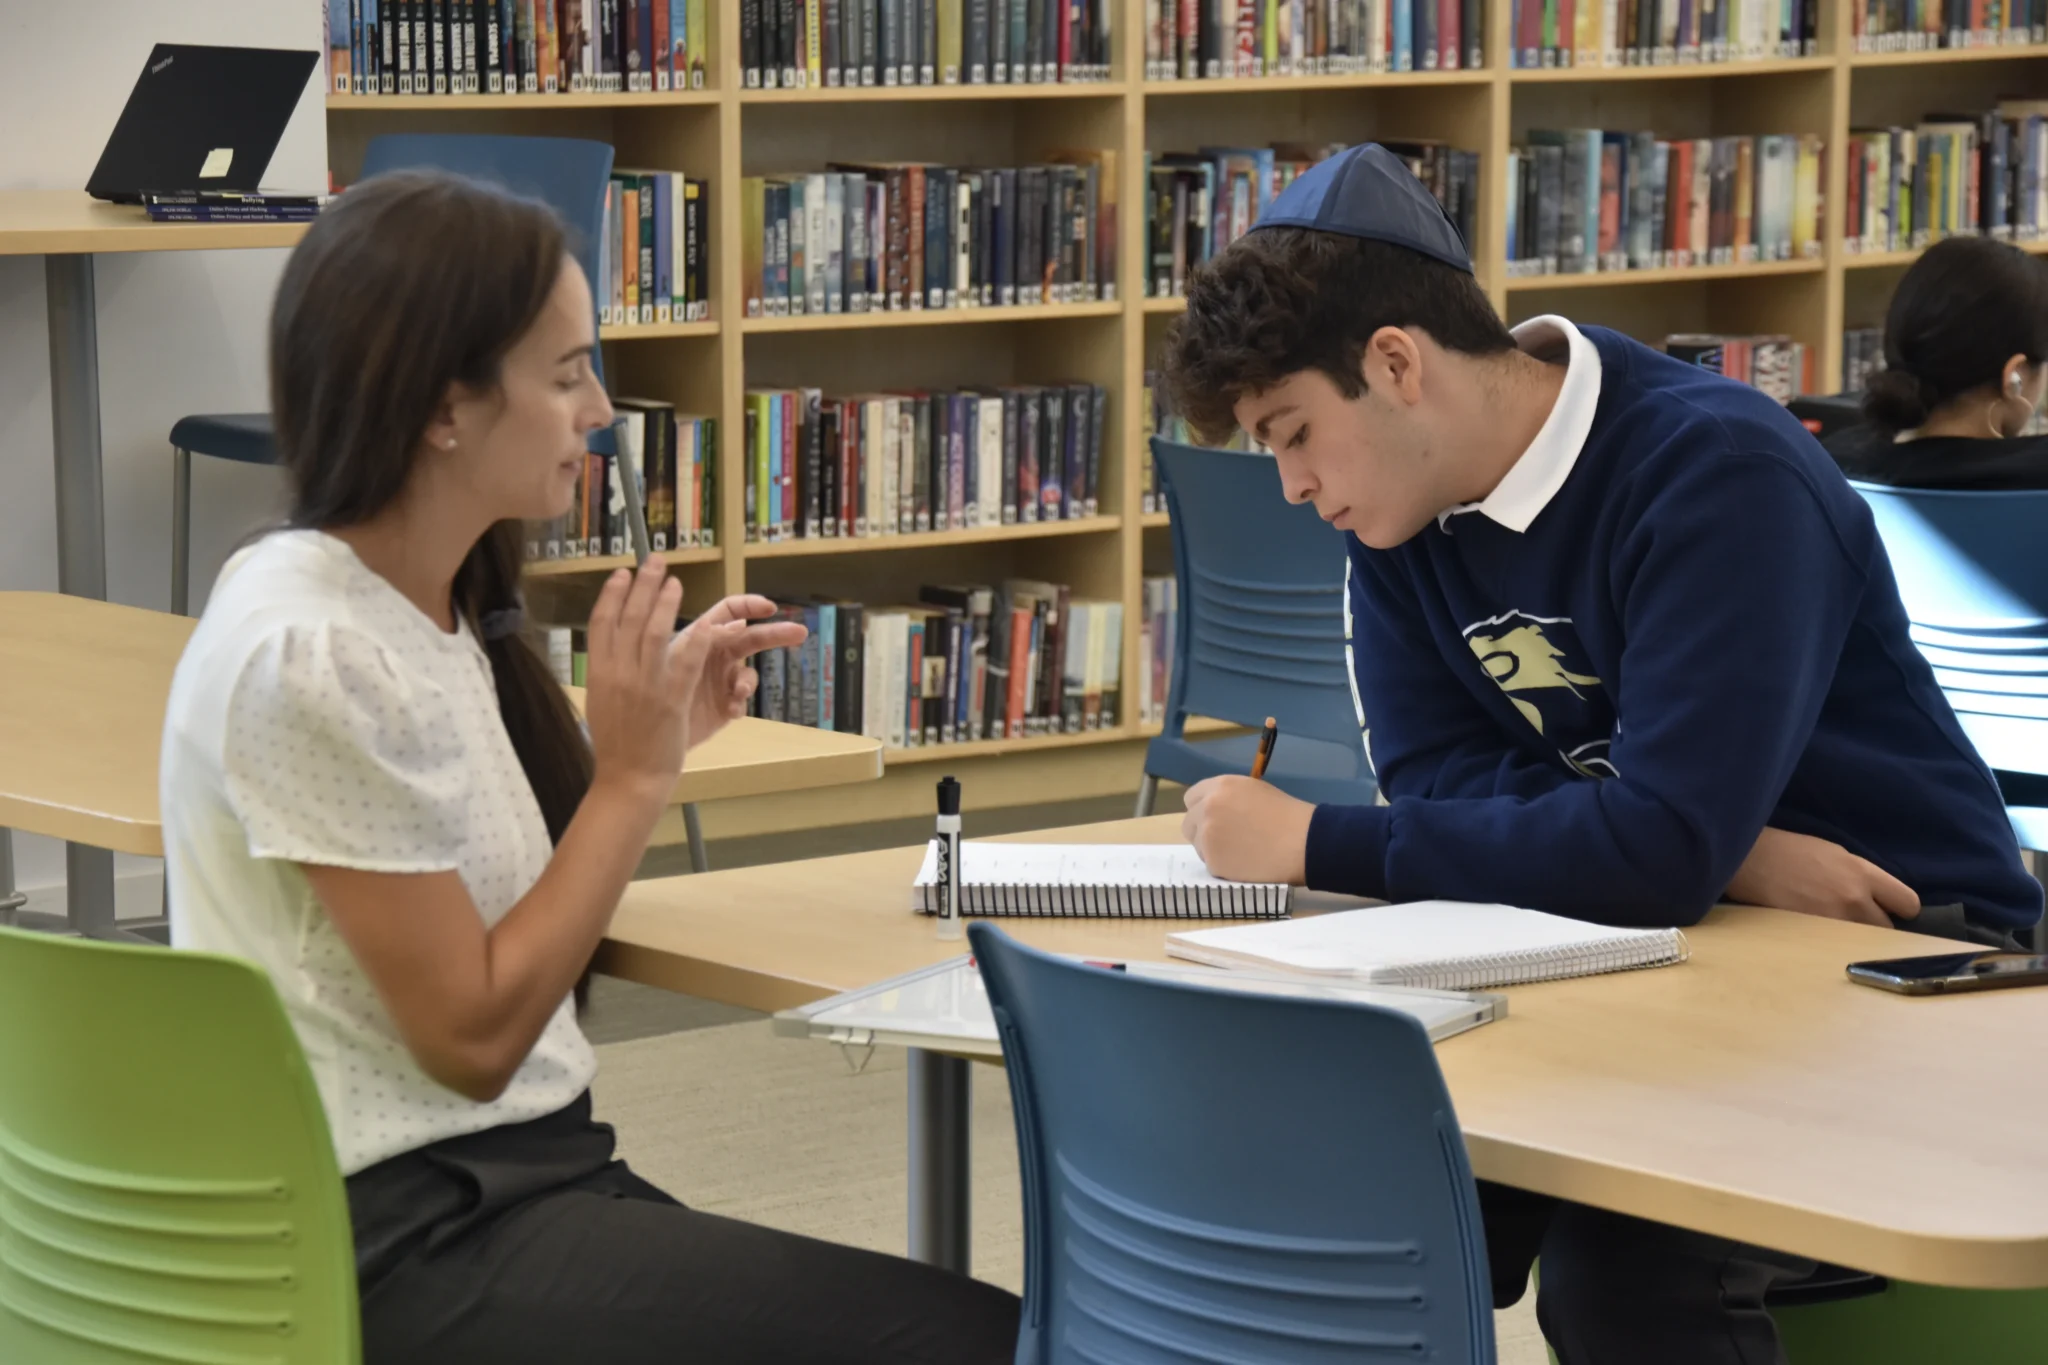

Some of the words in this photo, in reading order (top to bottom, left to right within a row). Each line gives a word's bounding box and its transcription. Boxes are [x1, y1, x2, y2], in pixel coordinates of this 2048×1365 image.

[488, 22, 499, 66] SCORPIA
[433, 43, 444, 70] ANGEL
[241, 196, 265, 204] Bullying
[687, 204, 696, 228] WHY
[687, 230, 696, 246] WE
[687, 247, 696, 266] FLY
[938, 837, 948, 883] EXPO
